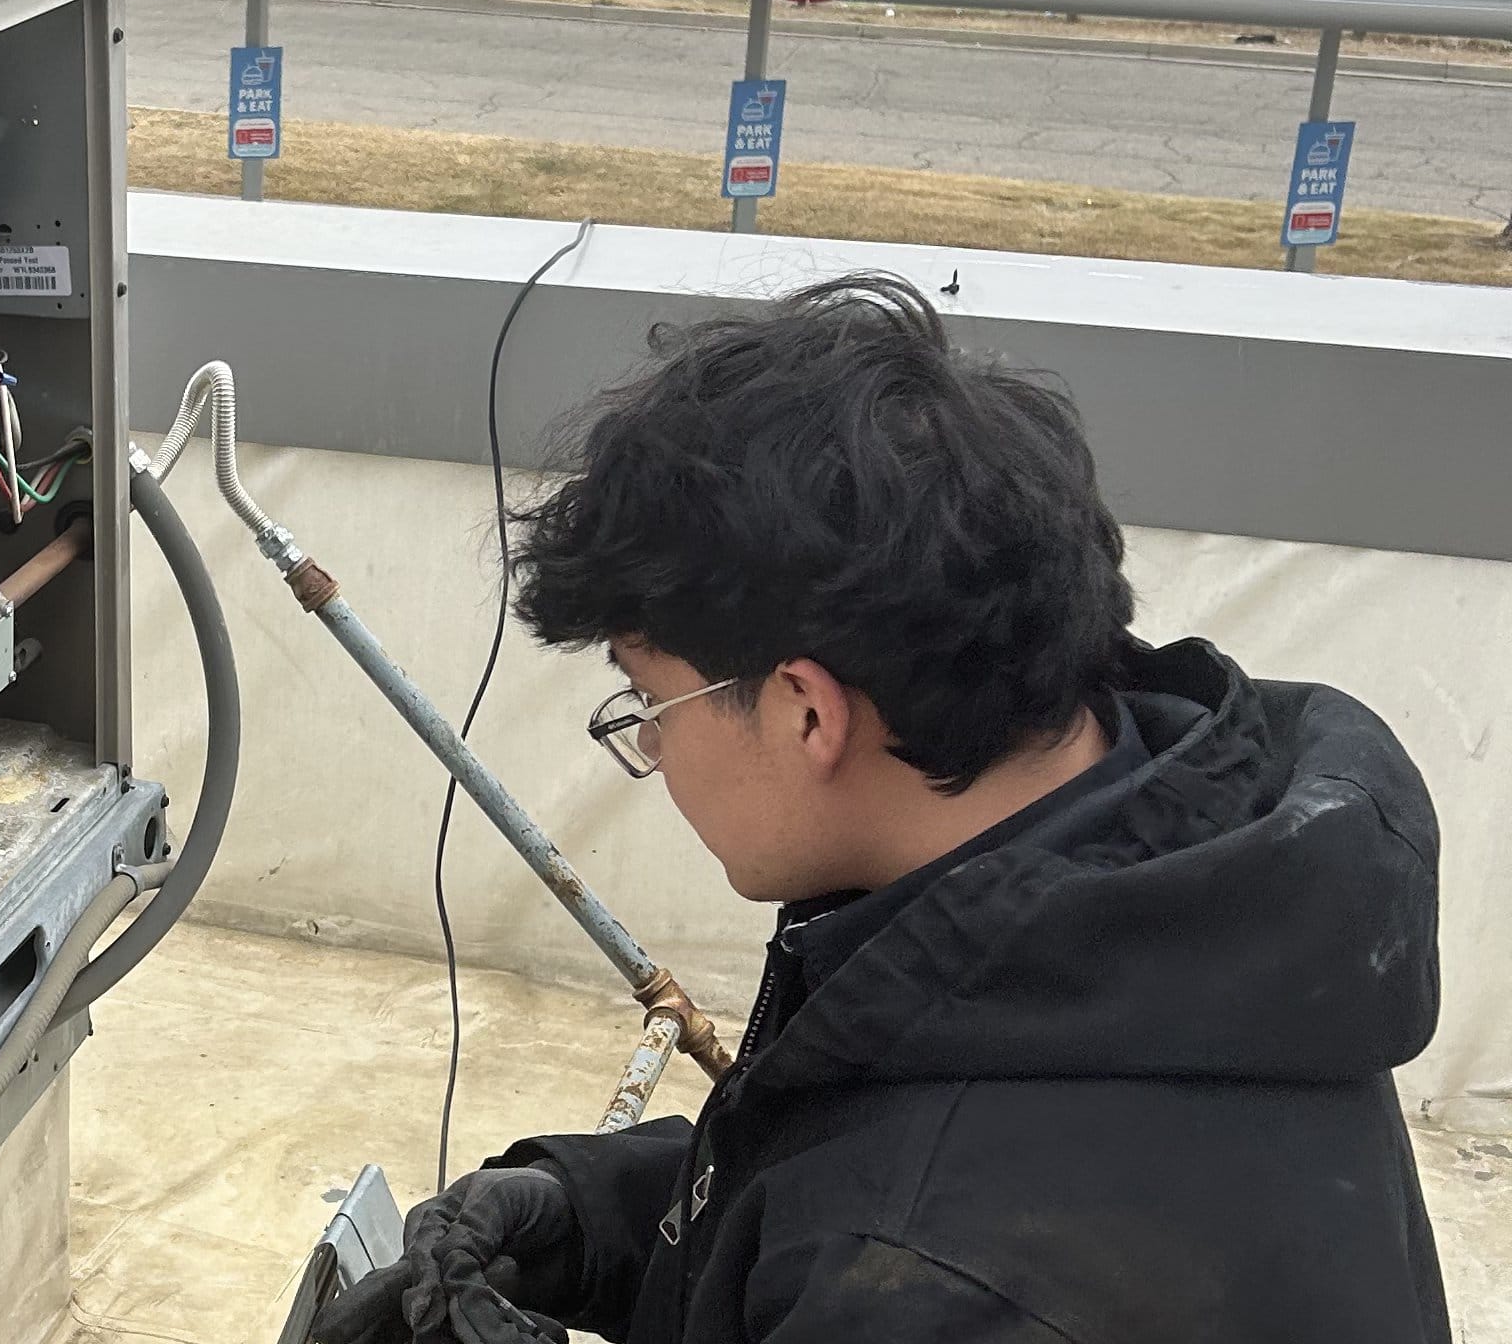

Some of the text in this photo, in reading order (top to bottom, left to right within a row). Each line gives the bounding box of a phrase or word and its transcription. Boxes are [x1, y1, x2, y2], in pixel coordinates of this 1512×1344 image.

[239, 88, 273, 100] PARK
[237, 101, 273, 113] & EAT
[736, 124, 772, 137] PARK
[734, 137, 773, 150] & EAT
[1301, 168, 1338, 181] PARK
[1297, 182, 1337, 195] & EAT
